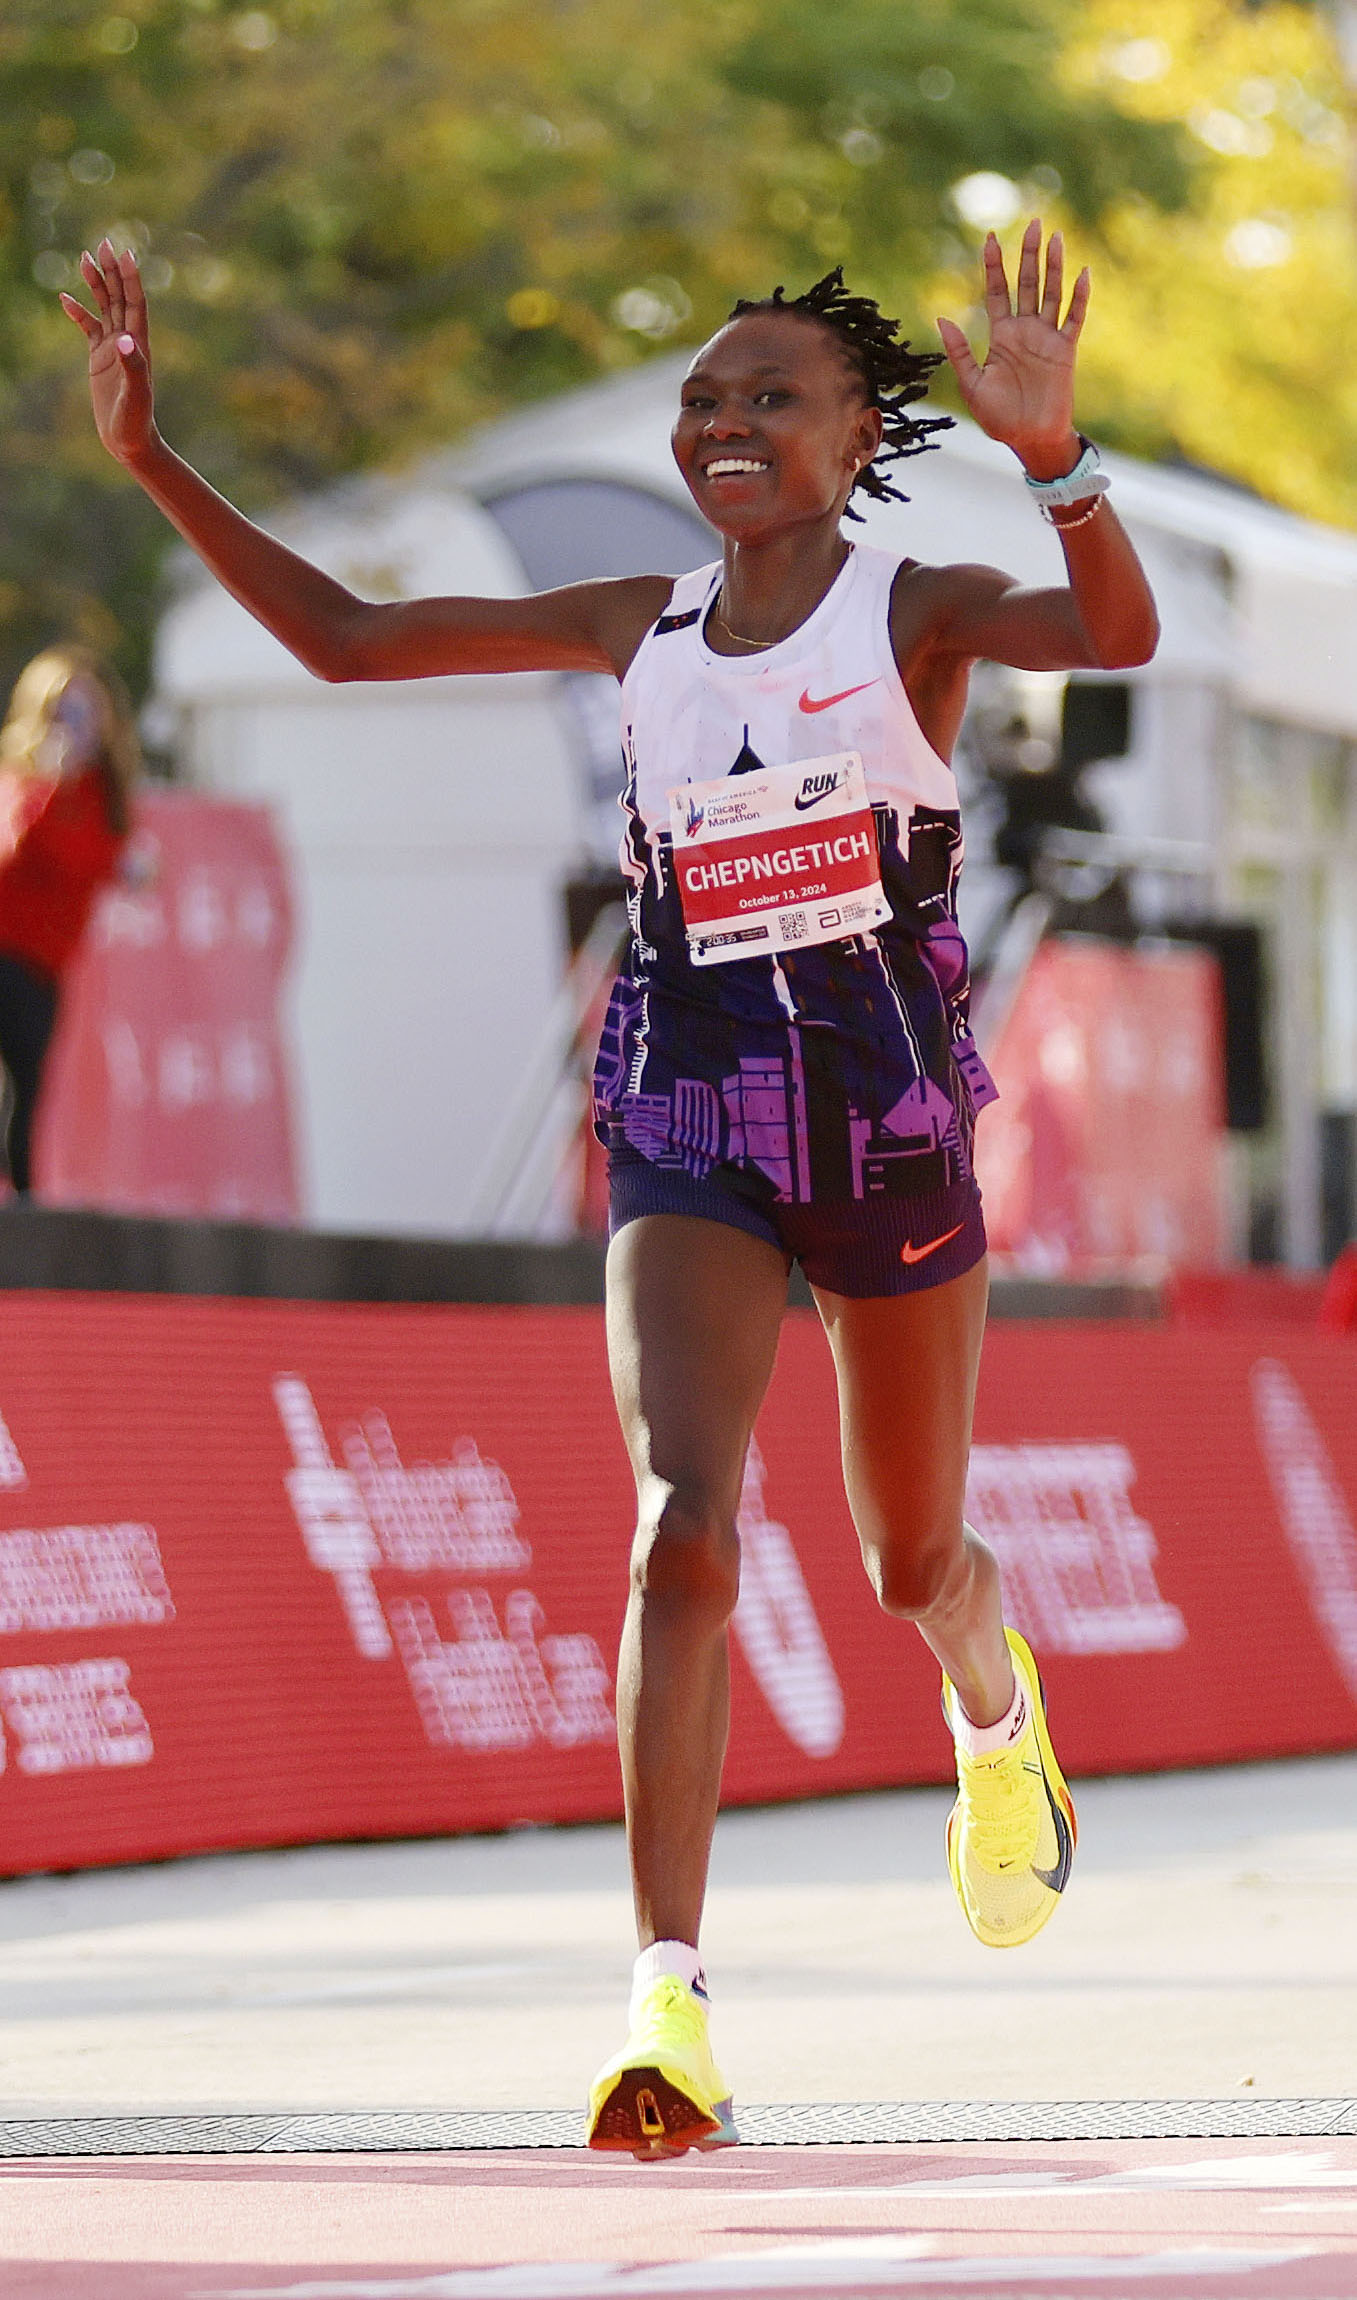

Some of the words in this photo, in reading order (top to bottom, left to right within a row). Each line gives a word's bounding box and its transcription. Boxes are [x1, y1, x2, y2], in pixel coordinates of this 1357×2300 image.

[801, 772, 838, 796] RUN
[708, 802, 748, 815] Chicago
[708, 812, 761, 828] Marathon
[685, 831, 871, 892] CHEPNGETICH
[739, 894, 780, 909] October
[782, 889, 800, 901] 13,
[800, 883, 828, 897] 2024
